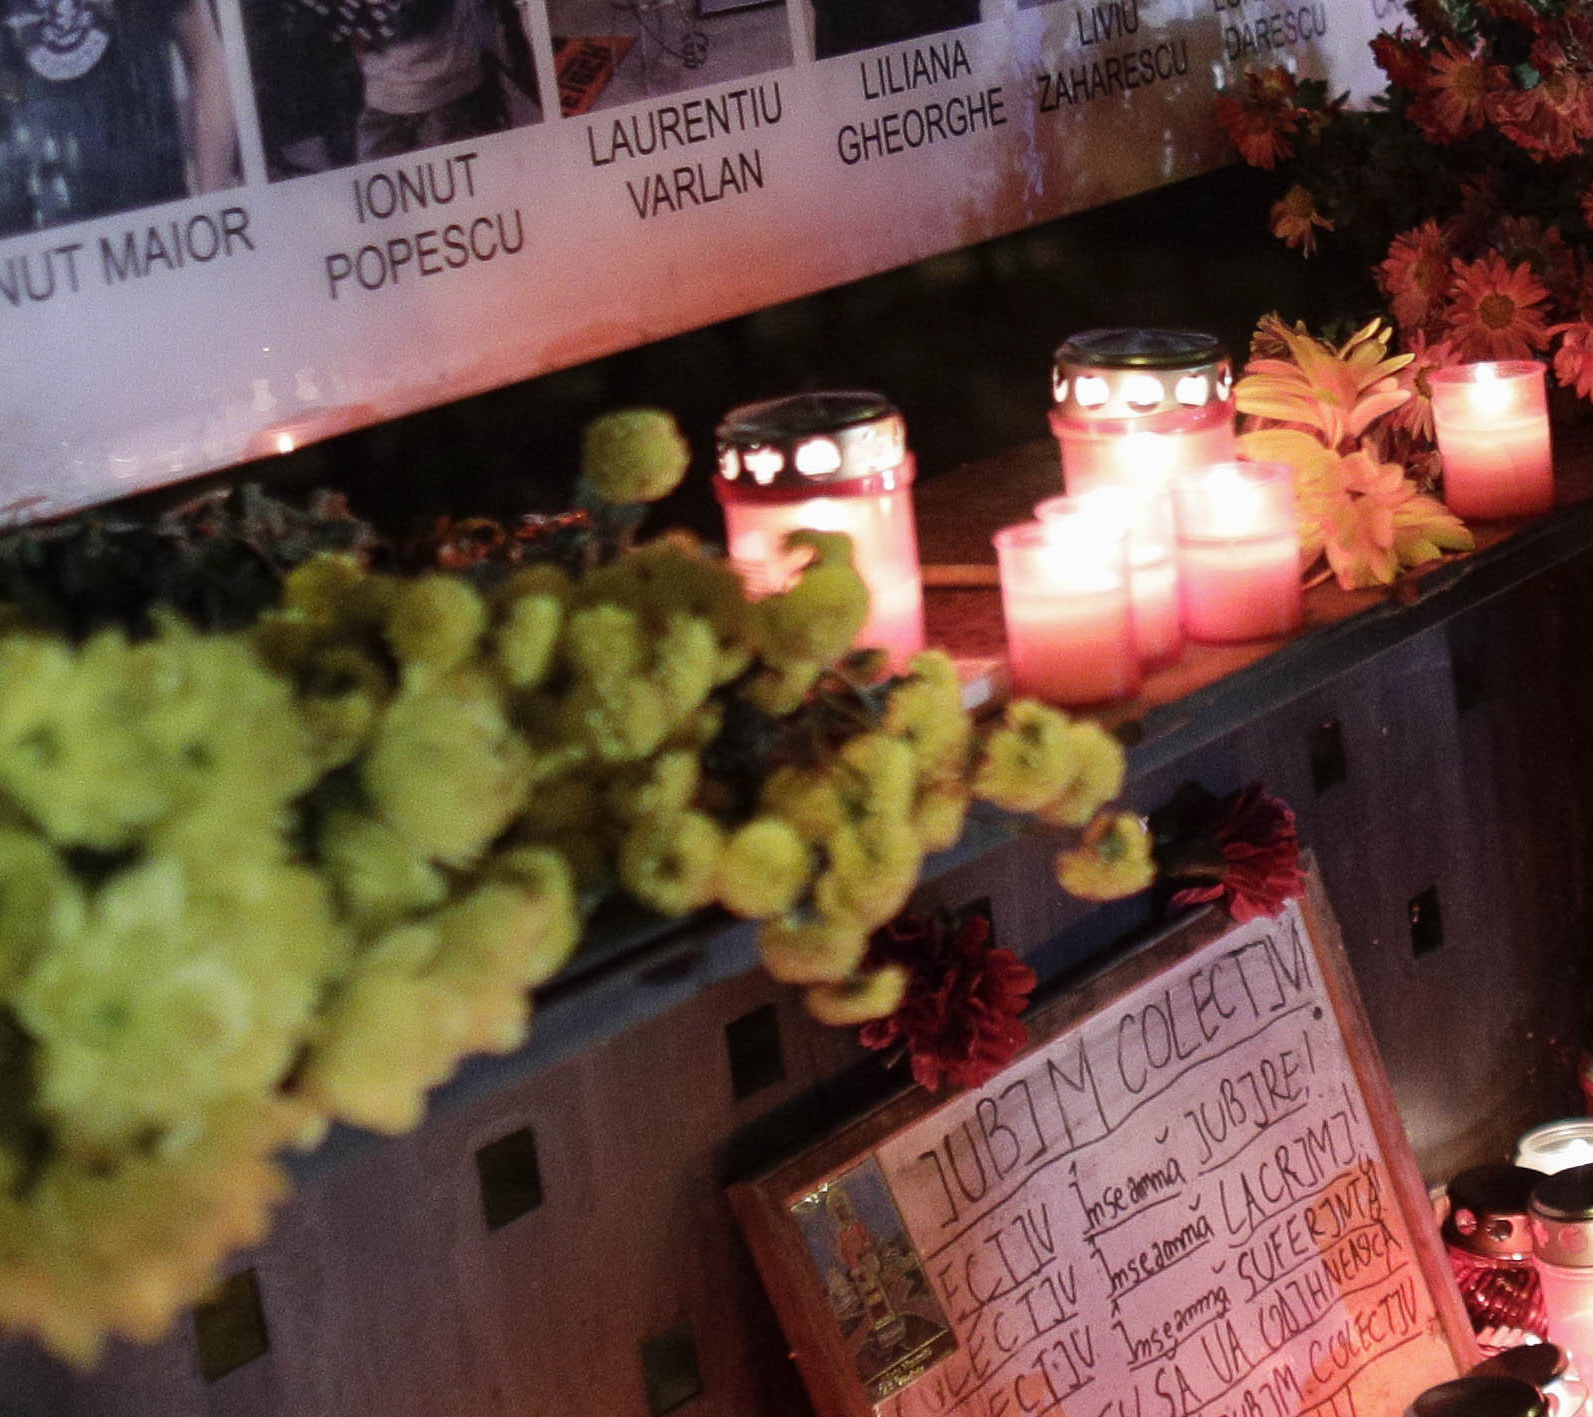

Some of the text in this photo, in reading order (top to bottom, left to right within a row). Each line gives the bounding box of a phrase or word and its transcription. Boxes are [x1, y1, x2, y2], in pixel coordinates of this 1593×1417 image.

[859, 38, 972, 102] LILIANA
[1224, 7, 1327, 63] DARESCU
[1037, 39, 1190, 113] ZAHARESCU
[585, 81, 784, 168] LAURENTIU
[836, 86, 1008, 167] GHEORGHE
[351, 151, 480, 226] IONUT
[625, 149, 766, 221] VARLAN
[98, 206, 256, 286] MAIOR
[324, 210, 527, 301] POPESCU
